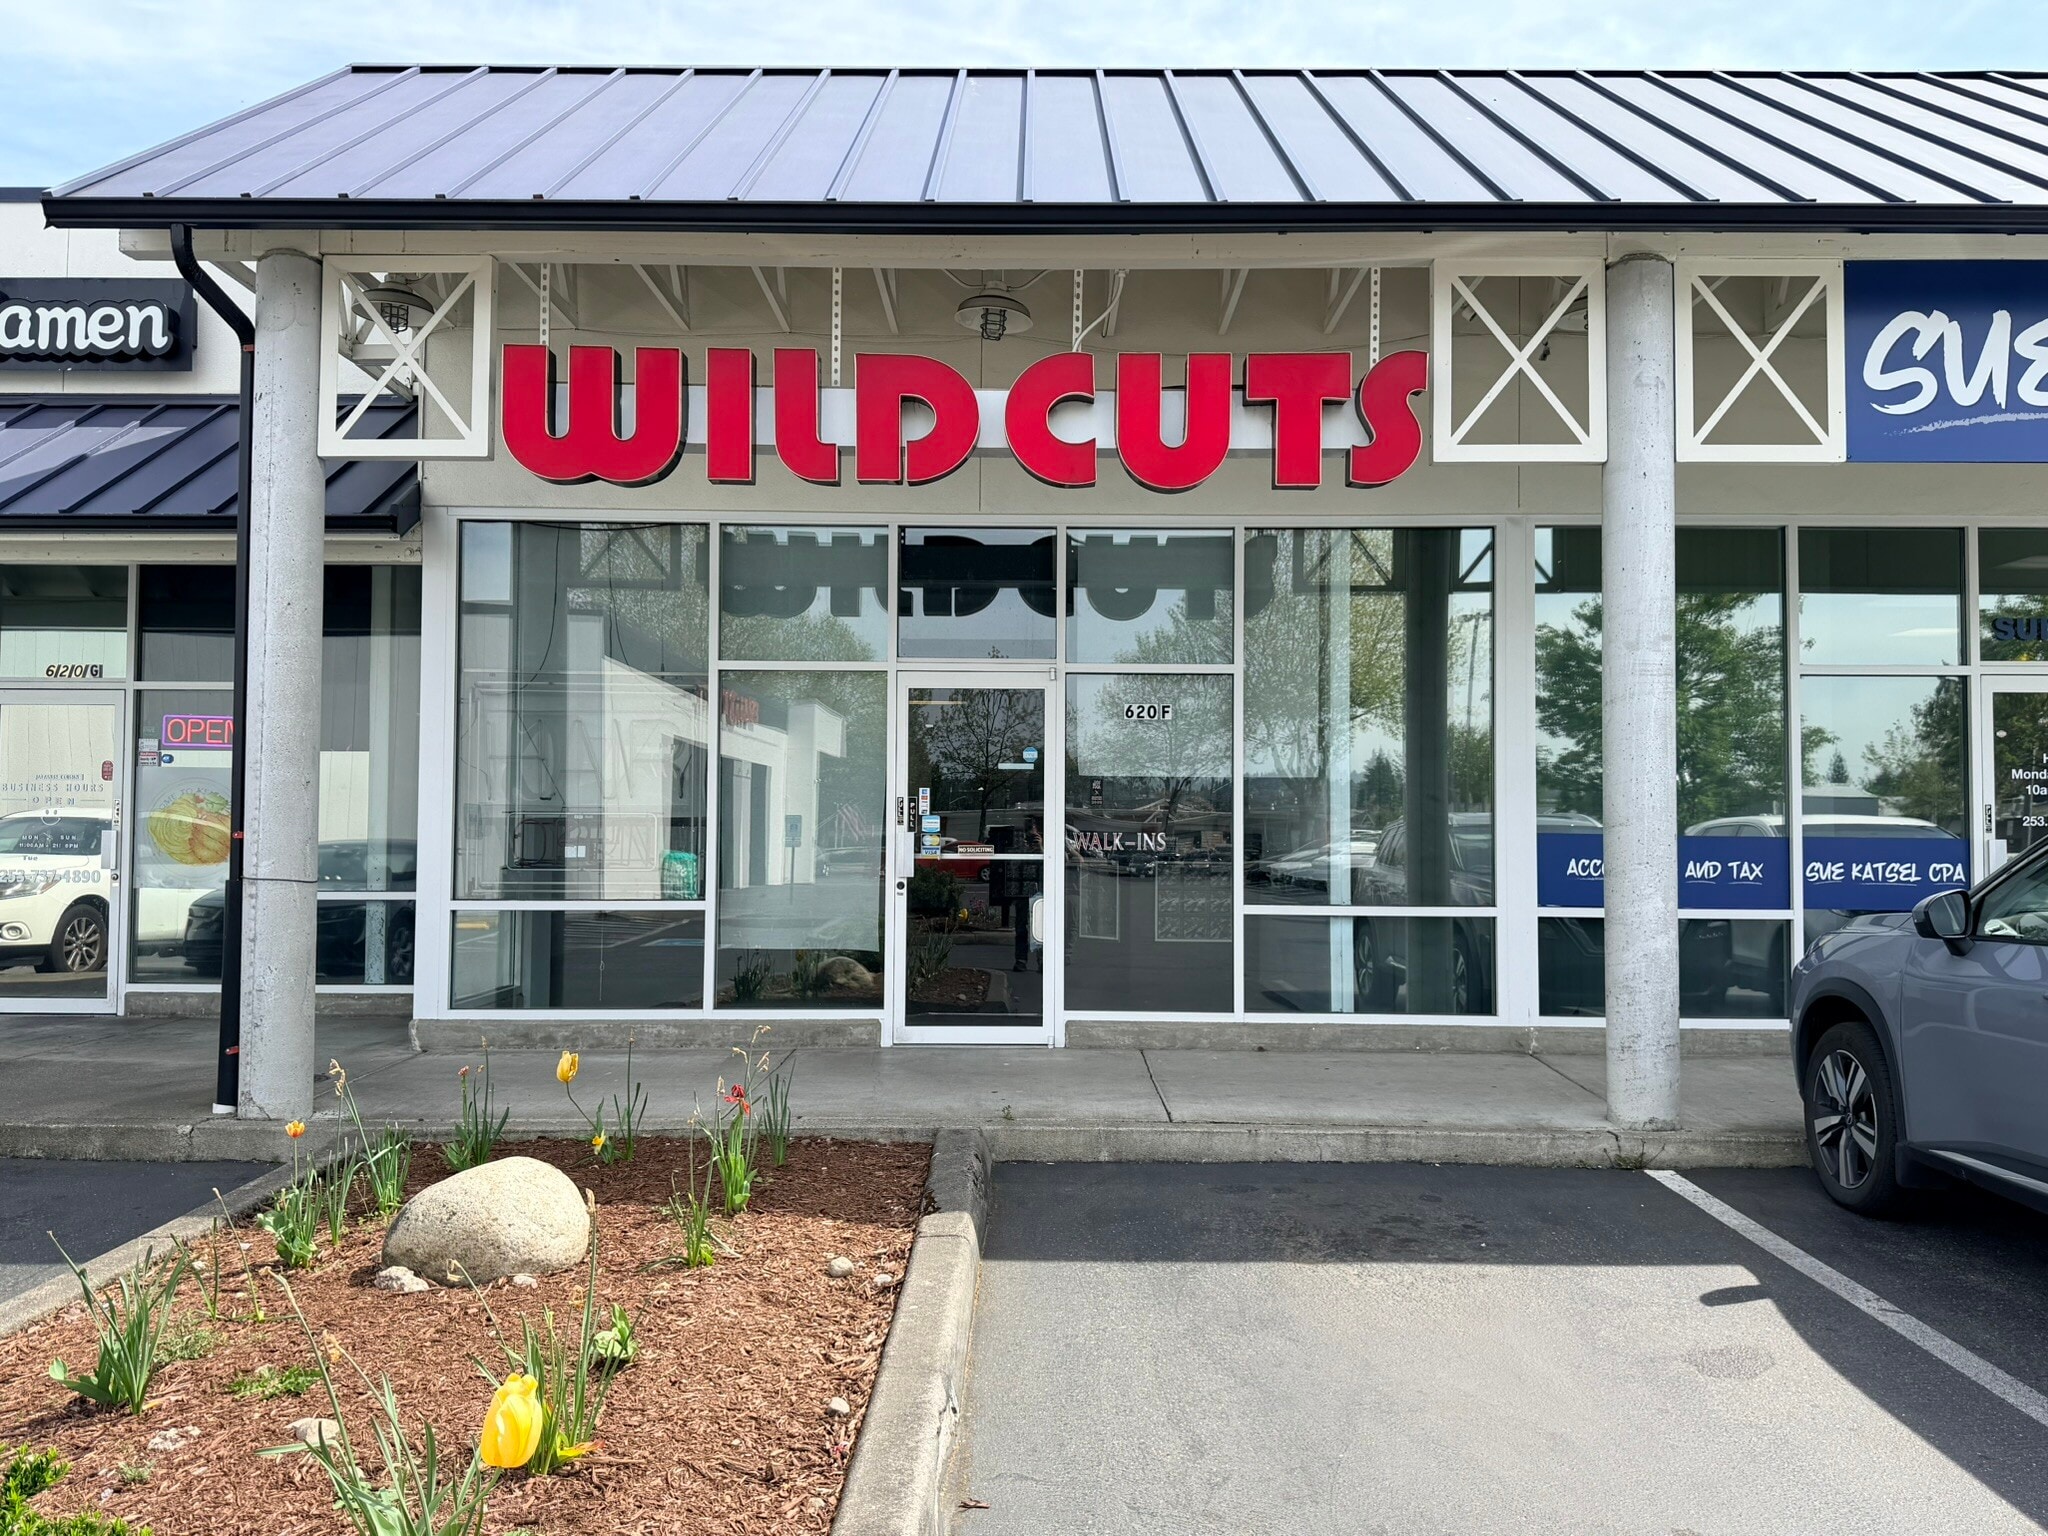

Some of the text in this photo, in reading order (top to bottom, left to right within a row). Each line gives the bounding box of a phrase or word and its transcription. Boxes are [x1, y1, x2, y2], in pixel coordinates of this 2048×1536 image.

[1863, 309, 2048, 415] SUE
[501, 343, 1430, 493] WILD CUTS
[2011, 769, 2048, 780] Mond
[1073, 832, 1167, 851] WALK-INS
[1566, 858, 1763, 880] ACC AND TAX
[1805, 861, 1966, 882] SUE KATSEL CPA
